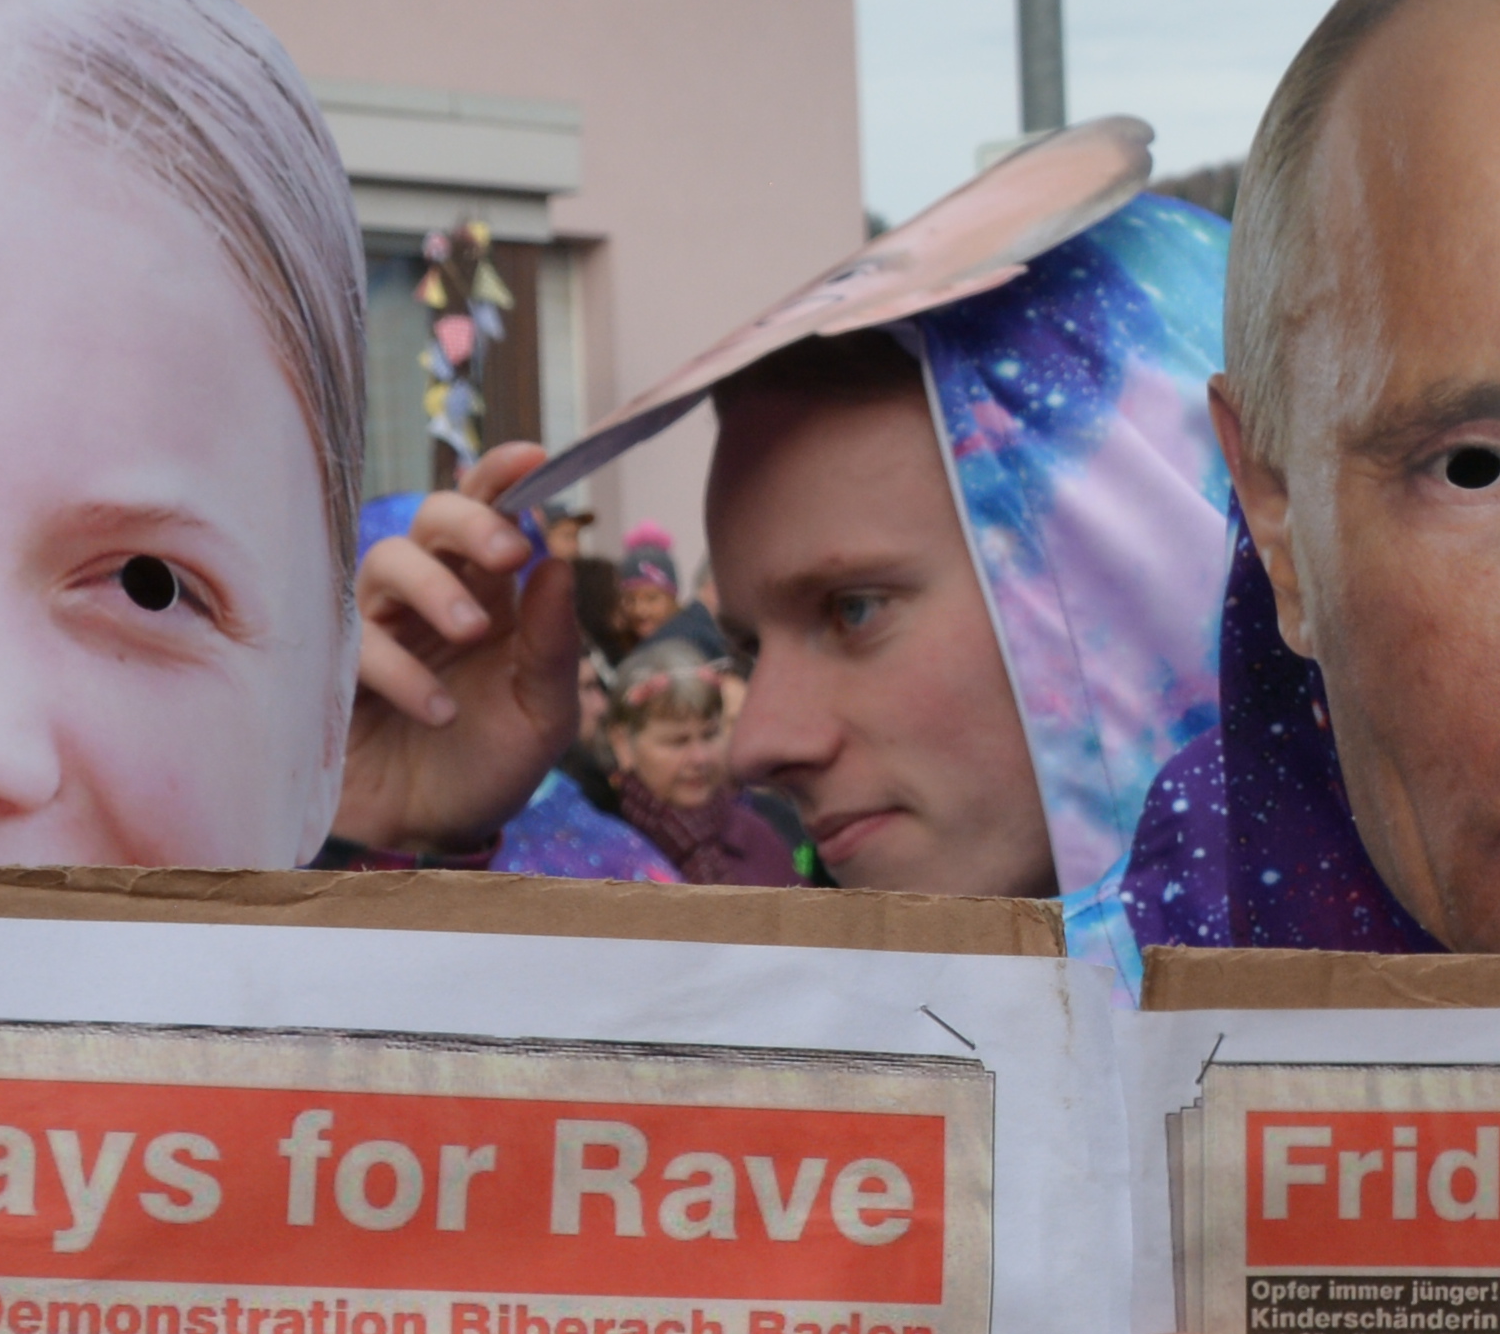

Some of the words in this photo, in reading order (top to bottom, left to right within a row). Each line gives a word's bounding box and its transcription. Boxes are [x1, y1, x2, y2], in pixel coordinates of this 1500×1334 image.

[279, 1109, 496, 1230] for
[551, 1119, 913, 1245] Rave
[1252, 1280, 1321, 1304] Opfer
[1330, 1280, 1404, 1300] immer
[1411, 1281, 1498, 1305] jünger!
[1252, 1307, 1497, 1329] Kinderschänderin
